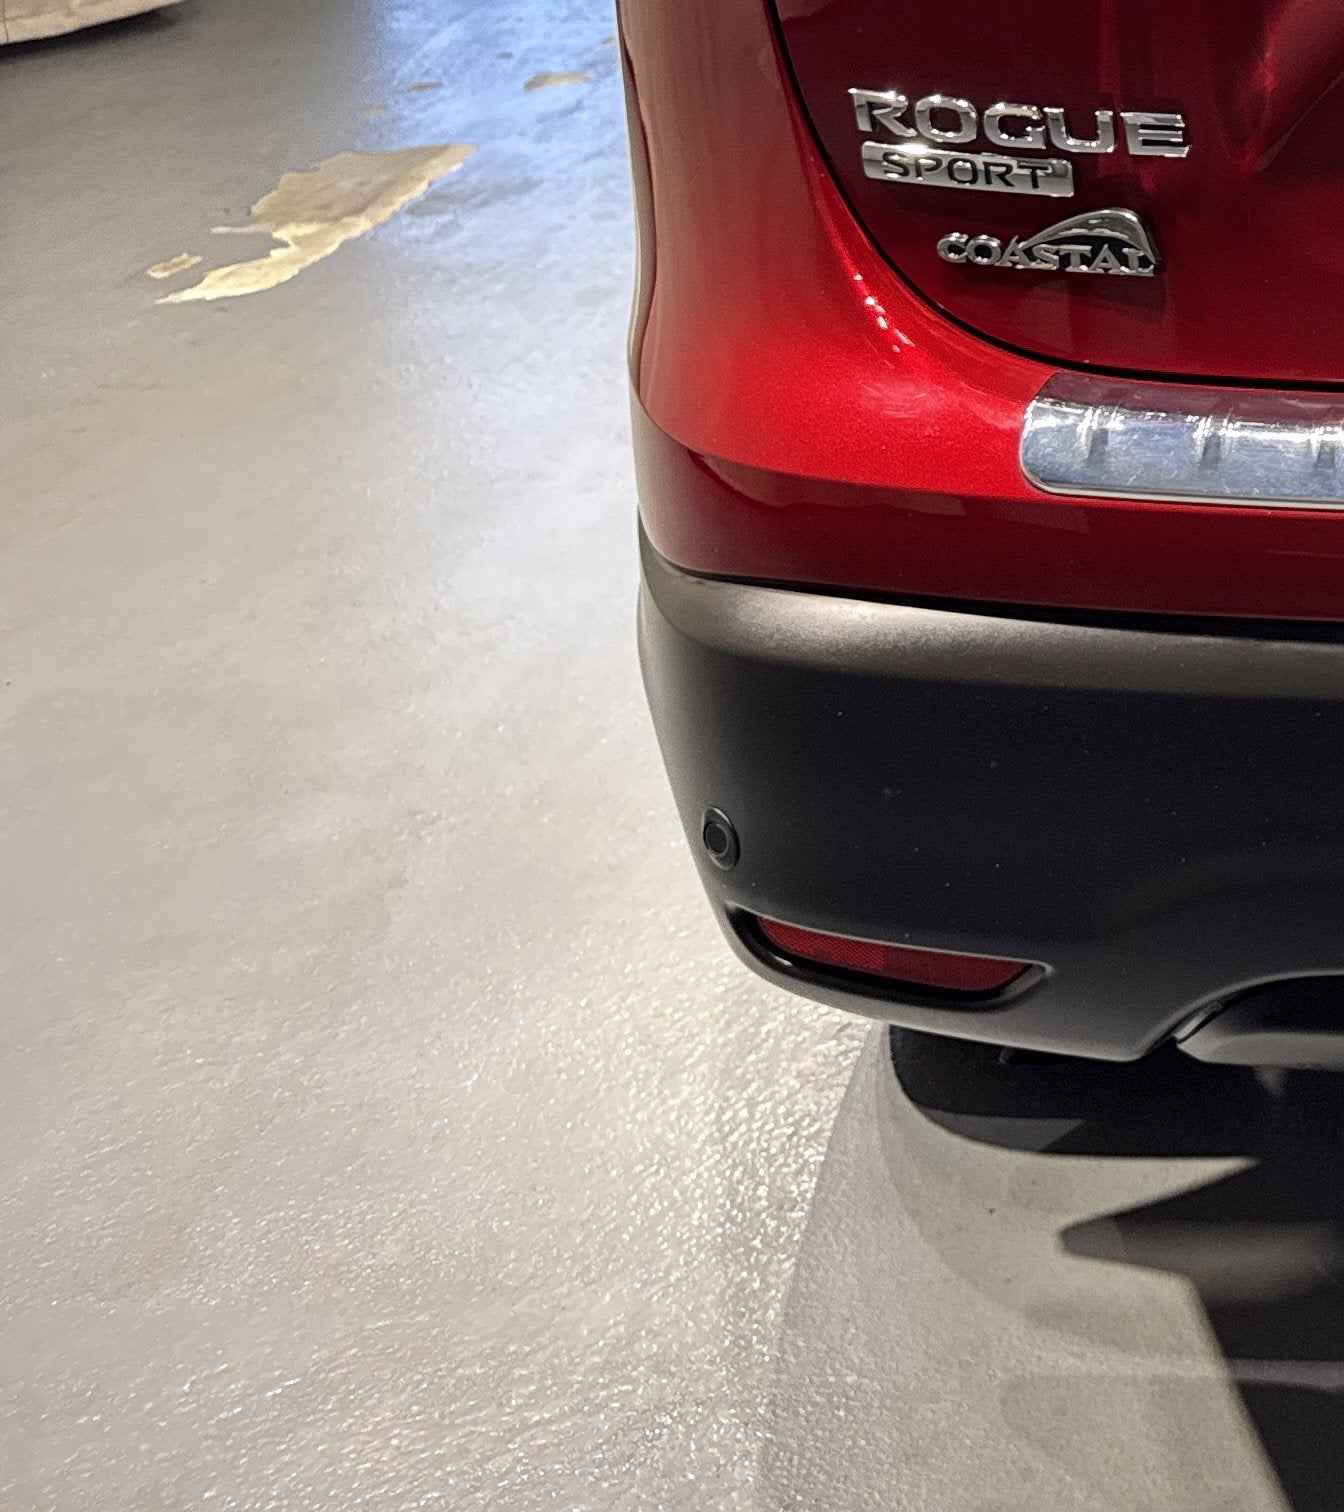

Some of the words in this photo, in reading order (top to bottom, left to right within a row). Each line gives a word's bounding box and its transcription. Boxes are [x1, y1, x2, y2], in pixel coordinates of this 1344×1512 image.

[847, 87, 1192, 158] ROGUE
[881, 150, 1054, 190] SPORT
[935, 231, 1156, 278] COASTAL
